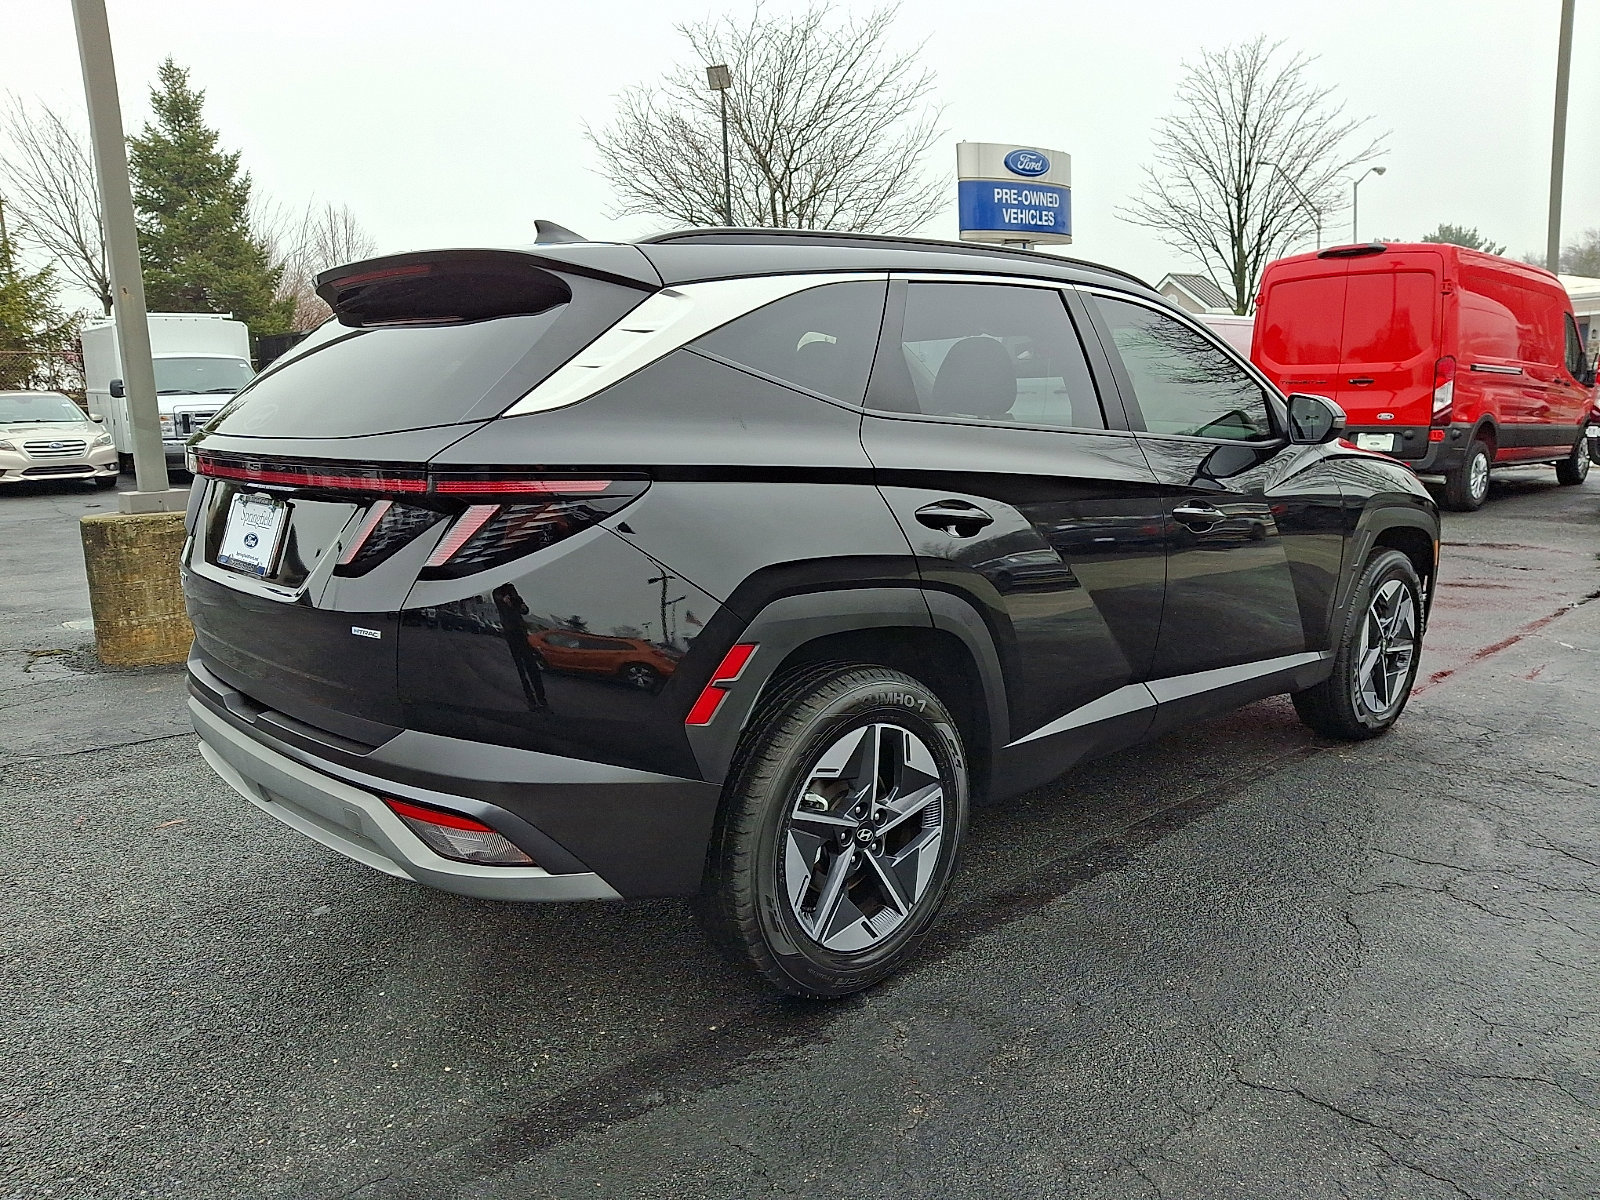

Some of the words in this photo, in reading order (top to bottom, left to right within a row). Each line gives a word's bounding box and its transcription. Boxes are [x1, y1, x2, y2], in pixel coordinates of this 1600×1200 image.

[1017, 153, 1043, 171] Ford
[994, 188, 1060, 208] PRE-OWNED
[1002, 208, 1055, 226] VEHICLES
